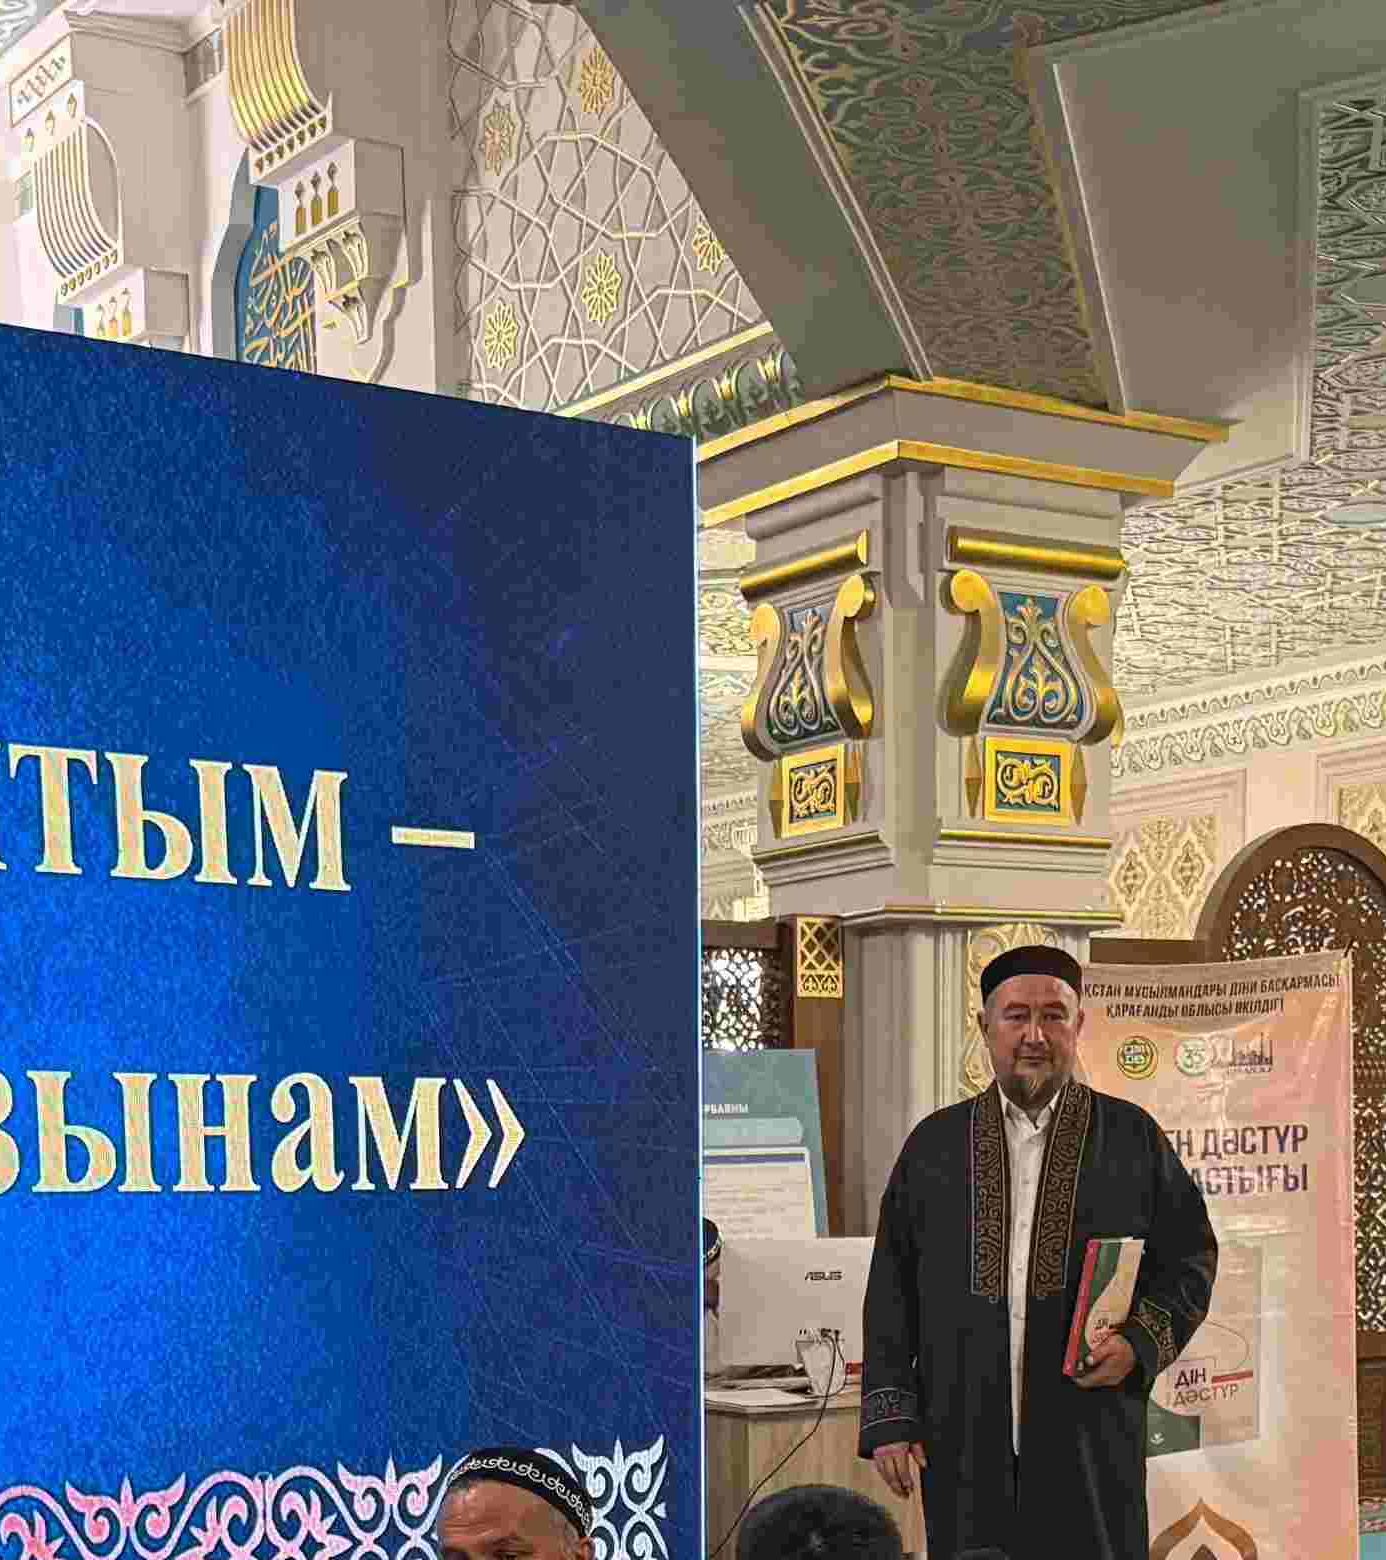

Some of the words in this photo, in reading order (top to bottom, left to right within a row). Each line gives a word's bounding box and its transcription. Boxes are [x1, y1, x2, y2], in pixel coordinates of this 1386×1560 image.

[1201, 1124, 1310, 1160] ДӘСТҮР
[804, 1271, 843, 1281] ASUS
[1175, 1368, 1206, 1389] ДІН
[1173, 1384, 1239, 1408] ДӘСТҮР
